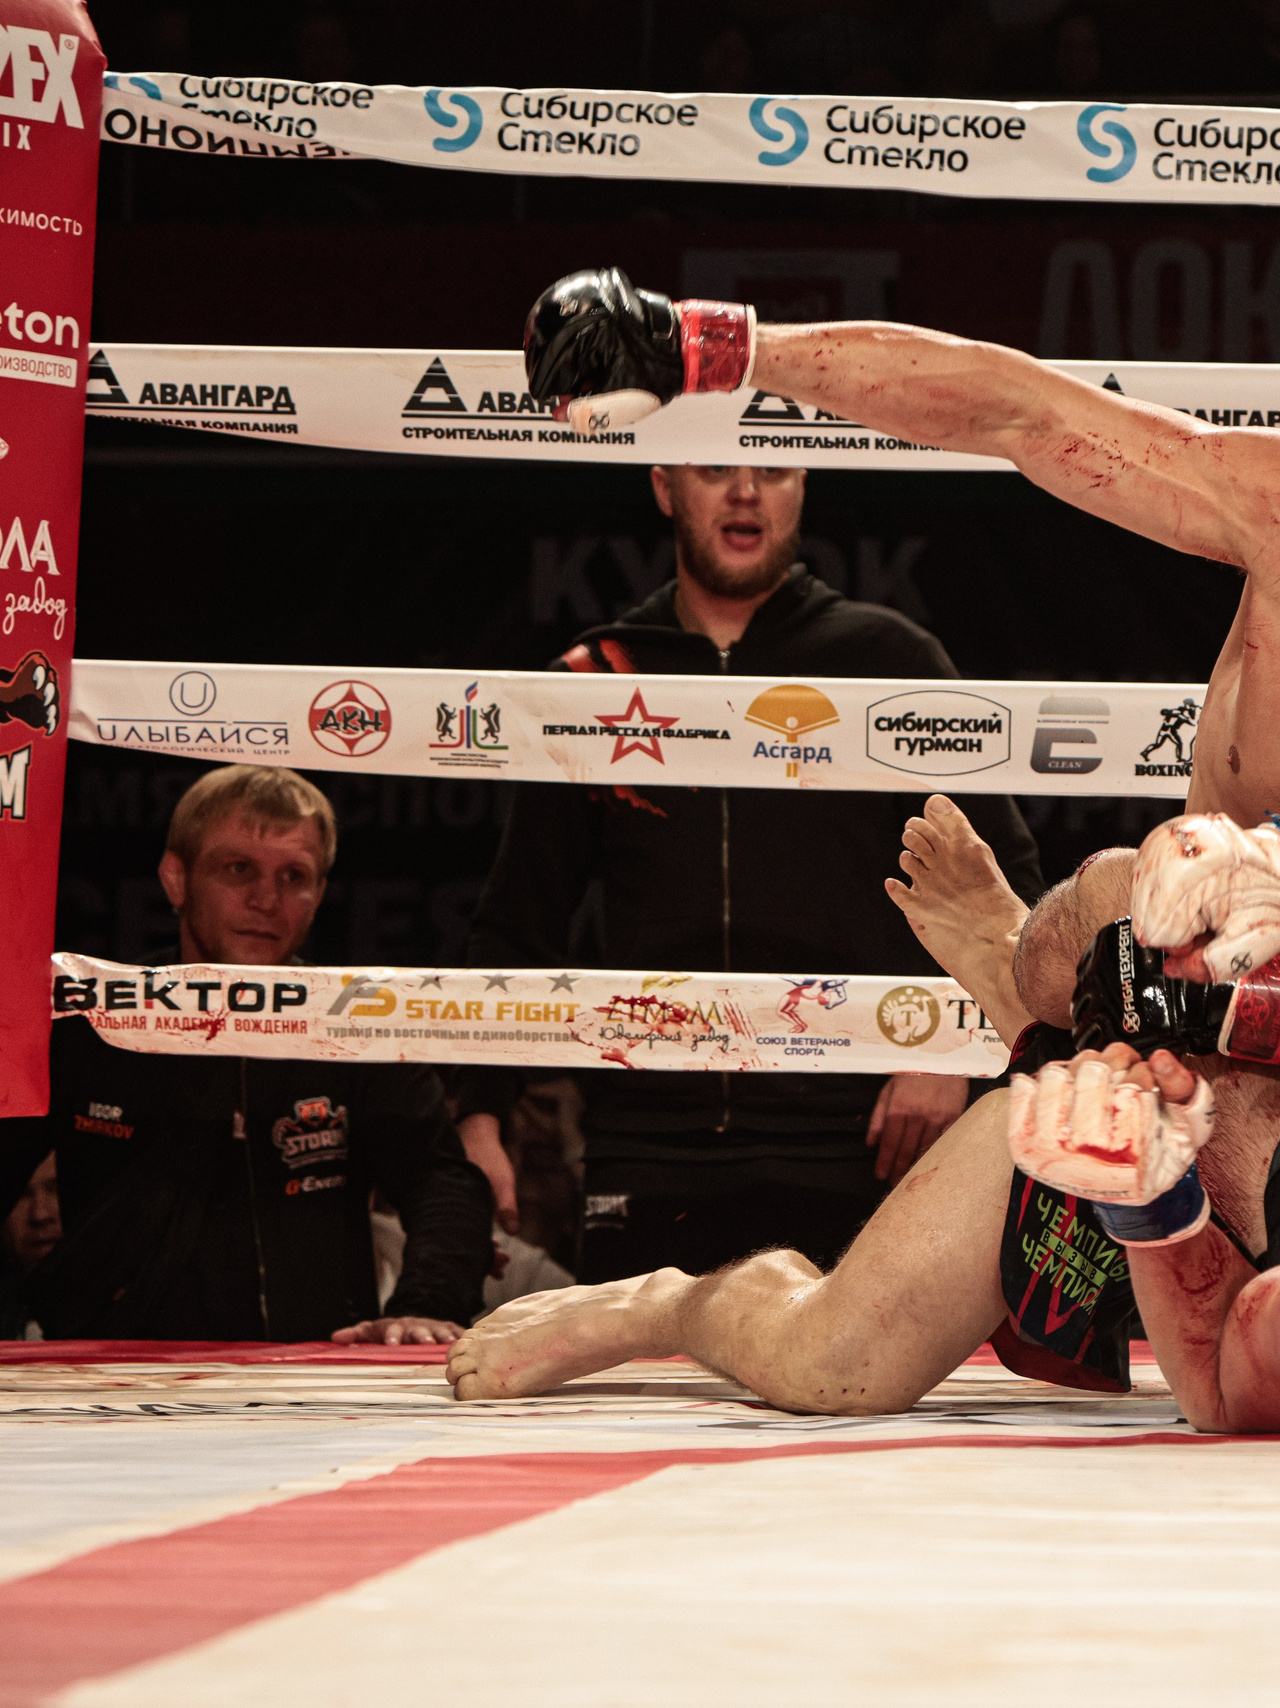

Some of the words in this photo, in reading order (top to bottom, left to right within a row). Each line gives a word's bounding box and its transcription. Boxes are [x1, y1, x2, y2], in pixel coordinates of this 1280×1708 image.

[501, 92, 698, 126] Сибирское
[826, 104, 1026, 142] Сибирское
[3, 122, 31, 150] IX
[498, 123, 640, 156] Стекло
[824, 138, 968, 171] Стекло
[0, 302, 79, 348] ton
[139, 383, 296, 414] АВАНГАРД
[477, 391, 555, 415] АВАН
[201, 420, 298, 434] КОМПАНИЯ
[402, 427, 533, 442] СТРОИТЕЛЬНАЯ
[739, 435, 869, 450] СТРОИТЕЛЬНАЯ
[543, 724, 596, 735] ПЕРВАЯ
[662, 728, 731, 740] ФАБРИКА
[875, 711, 1001, 734] сибирский
[753, 741, 832, 763] Асгард
[895, 737, 982, 756] гурман
[1048, 761, 1082, 769] CLEAN
[1119, 924, 1136, 1013] FIGHTEXPERT
[54, 971, 307, 1012] ВЕКТОР
[405, 1000, 484, 1020] STAR
[496, 1002, 580, 1022] FIGHT
[234, 1019, 308, 1035] ВОЖДЕНИЯ
[326, 1026, 373, 1038] турнир
[394, 1028, 470, 1040] восточным
[473, 1029, 580, 1043] единоборствам
[691, 1026, 730, 1051] завод
[756, 1037, 786, 1045] СОЮЗ
[791, 1038, 850, 1047] ВЕТЕРАНОВ
[784, 1047, 825, 1056] СПОРТА
[1042, 1231, 1098, 1281] ВЫЗЫВ
